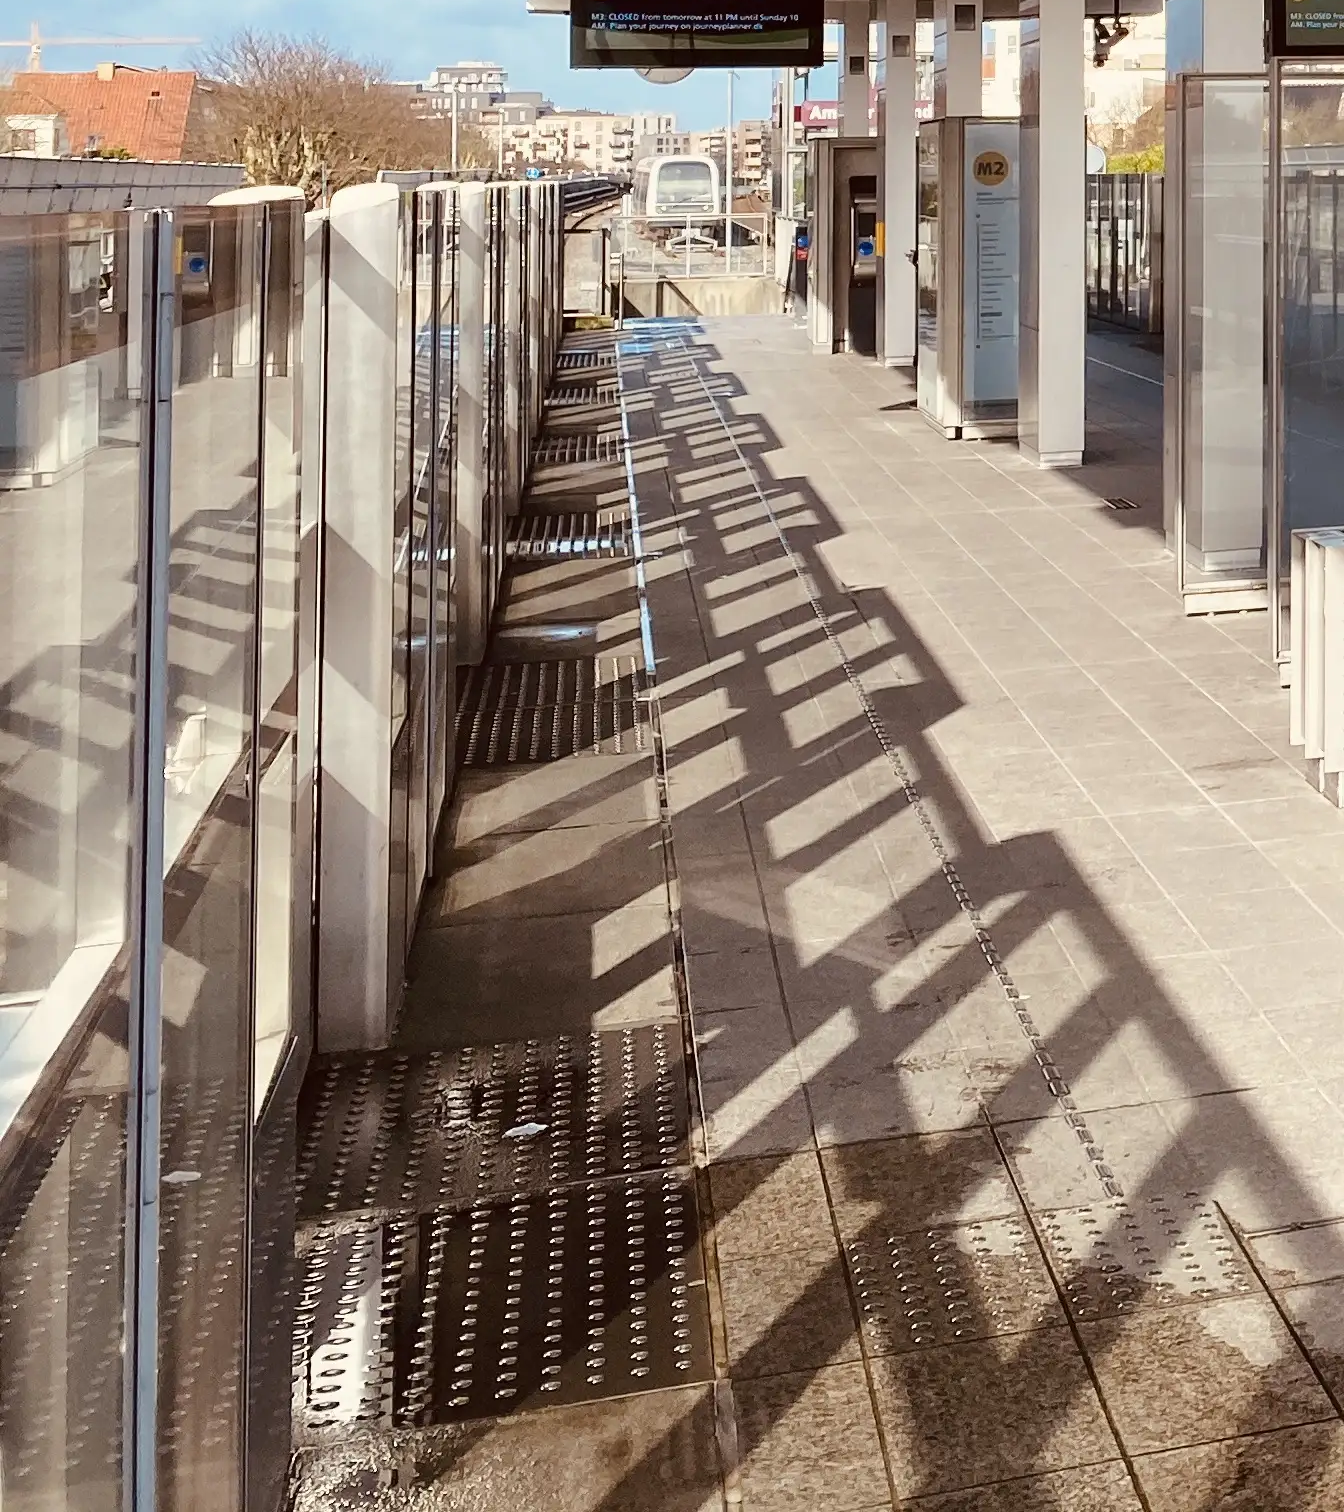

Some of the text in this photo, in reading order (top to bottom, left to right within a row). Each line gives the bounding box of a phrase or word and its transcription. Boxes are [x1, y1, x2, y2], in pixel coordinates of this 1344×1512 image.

[608, 13, 639, 21] CLOSED
[641, 13, 661, 21] from
[725, 13, 738, 21] PM
[760, 14, 788, 23] Sunday
[1305, 12, 1332, 20] CLOSED
[610, 22, 627, 30] Plan
[629, 23, 647, 31] your
[648, 22, 679, 31] journey
[977, 159, 1005, 176] M2
